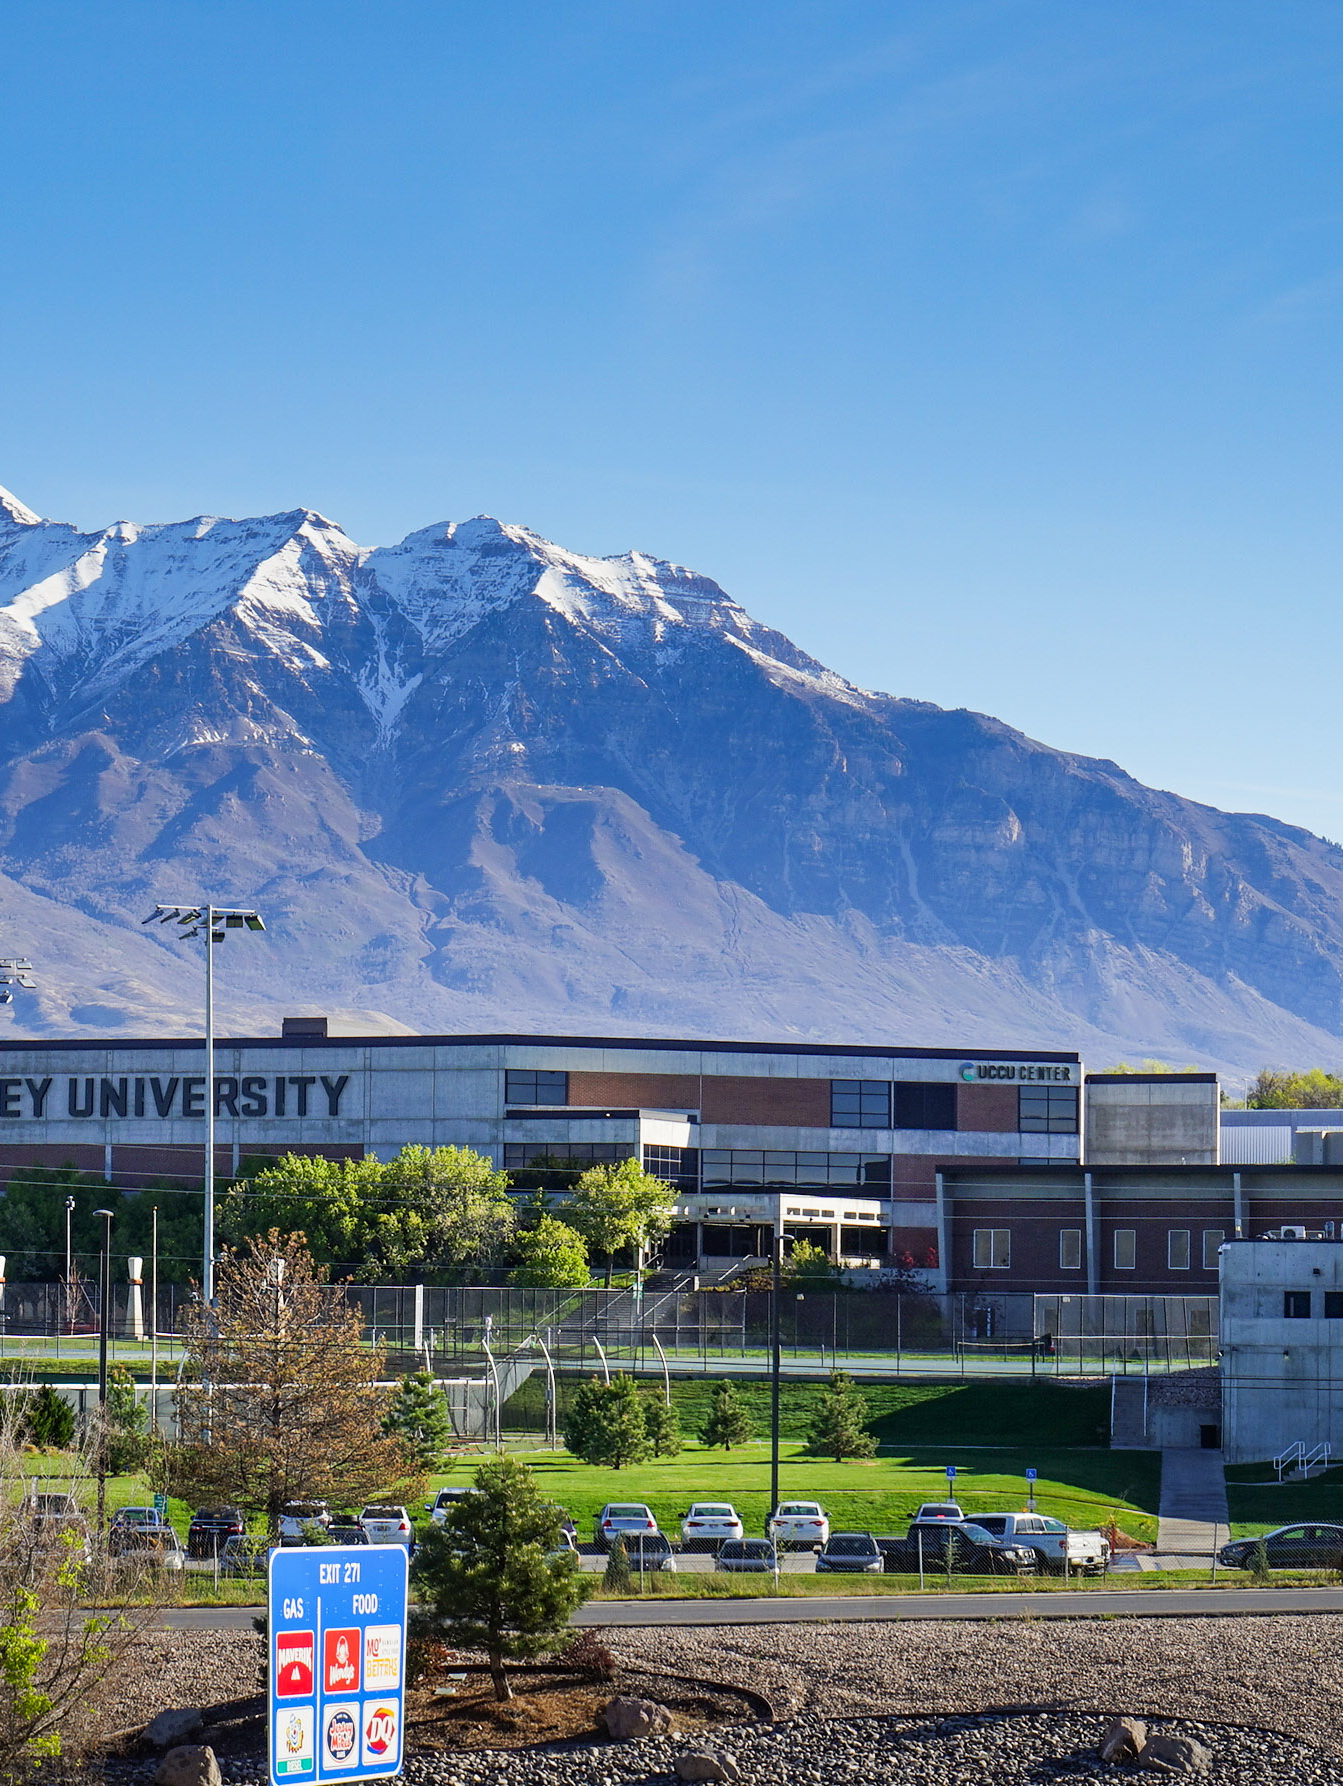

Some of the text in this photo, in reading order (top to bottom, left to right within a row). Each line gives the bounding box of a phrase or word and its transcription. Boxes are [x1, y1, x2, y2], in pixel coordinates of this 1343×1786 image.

[978, 1065, 1071, 1081] UCCU CENTER
[68, 1075, 349, 1118] UNIVERSITY
[319, 1562, 360, 1584] EXIT 271
[283, 1597, 304, 1620] GAS
[352, 1593, 378, 1615] FOOD
[278, 1647, 313, 1675] MAVERIK
[370, 1716, 393, 1746] DQ
